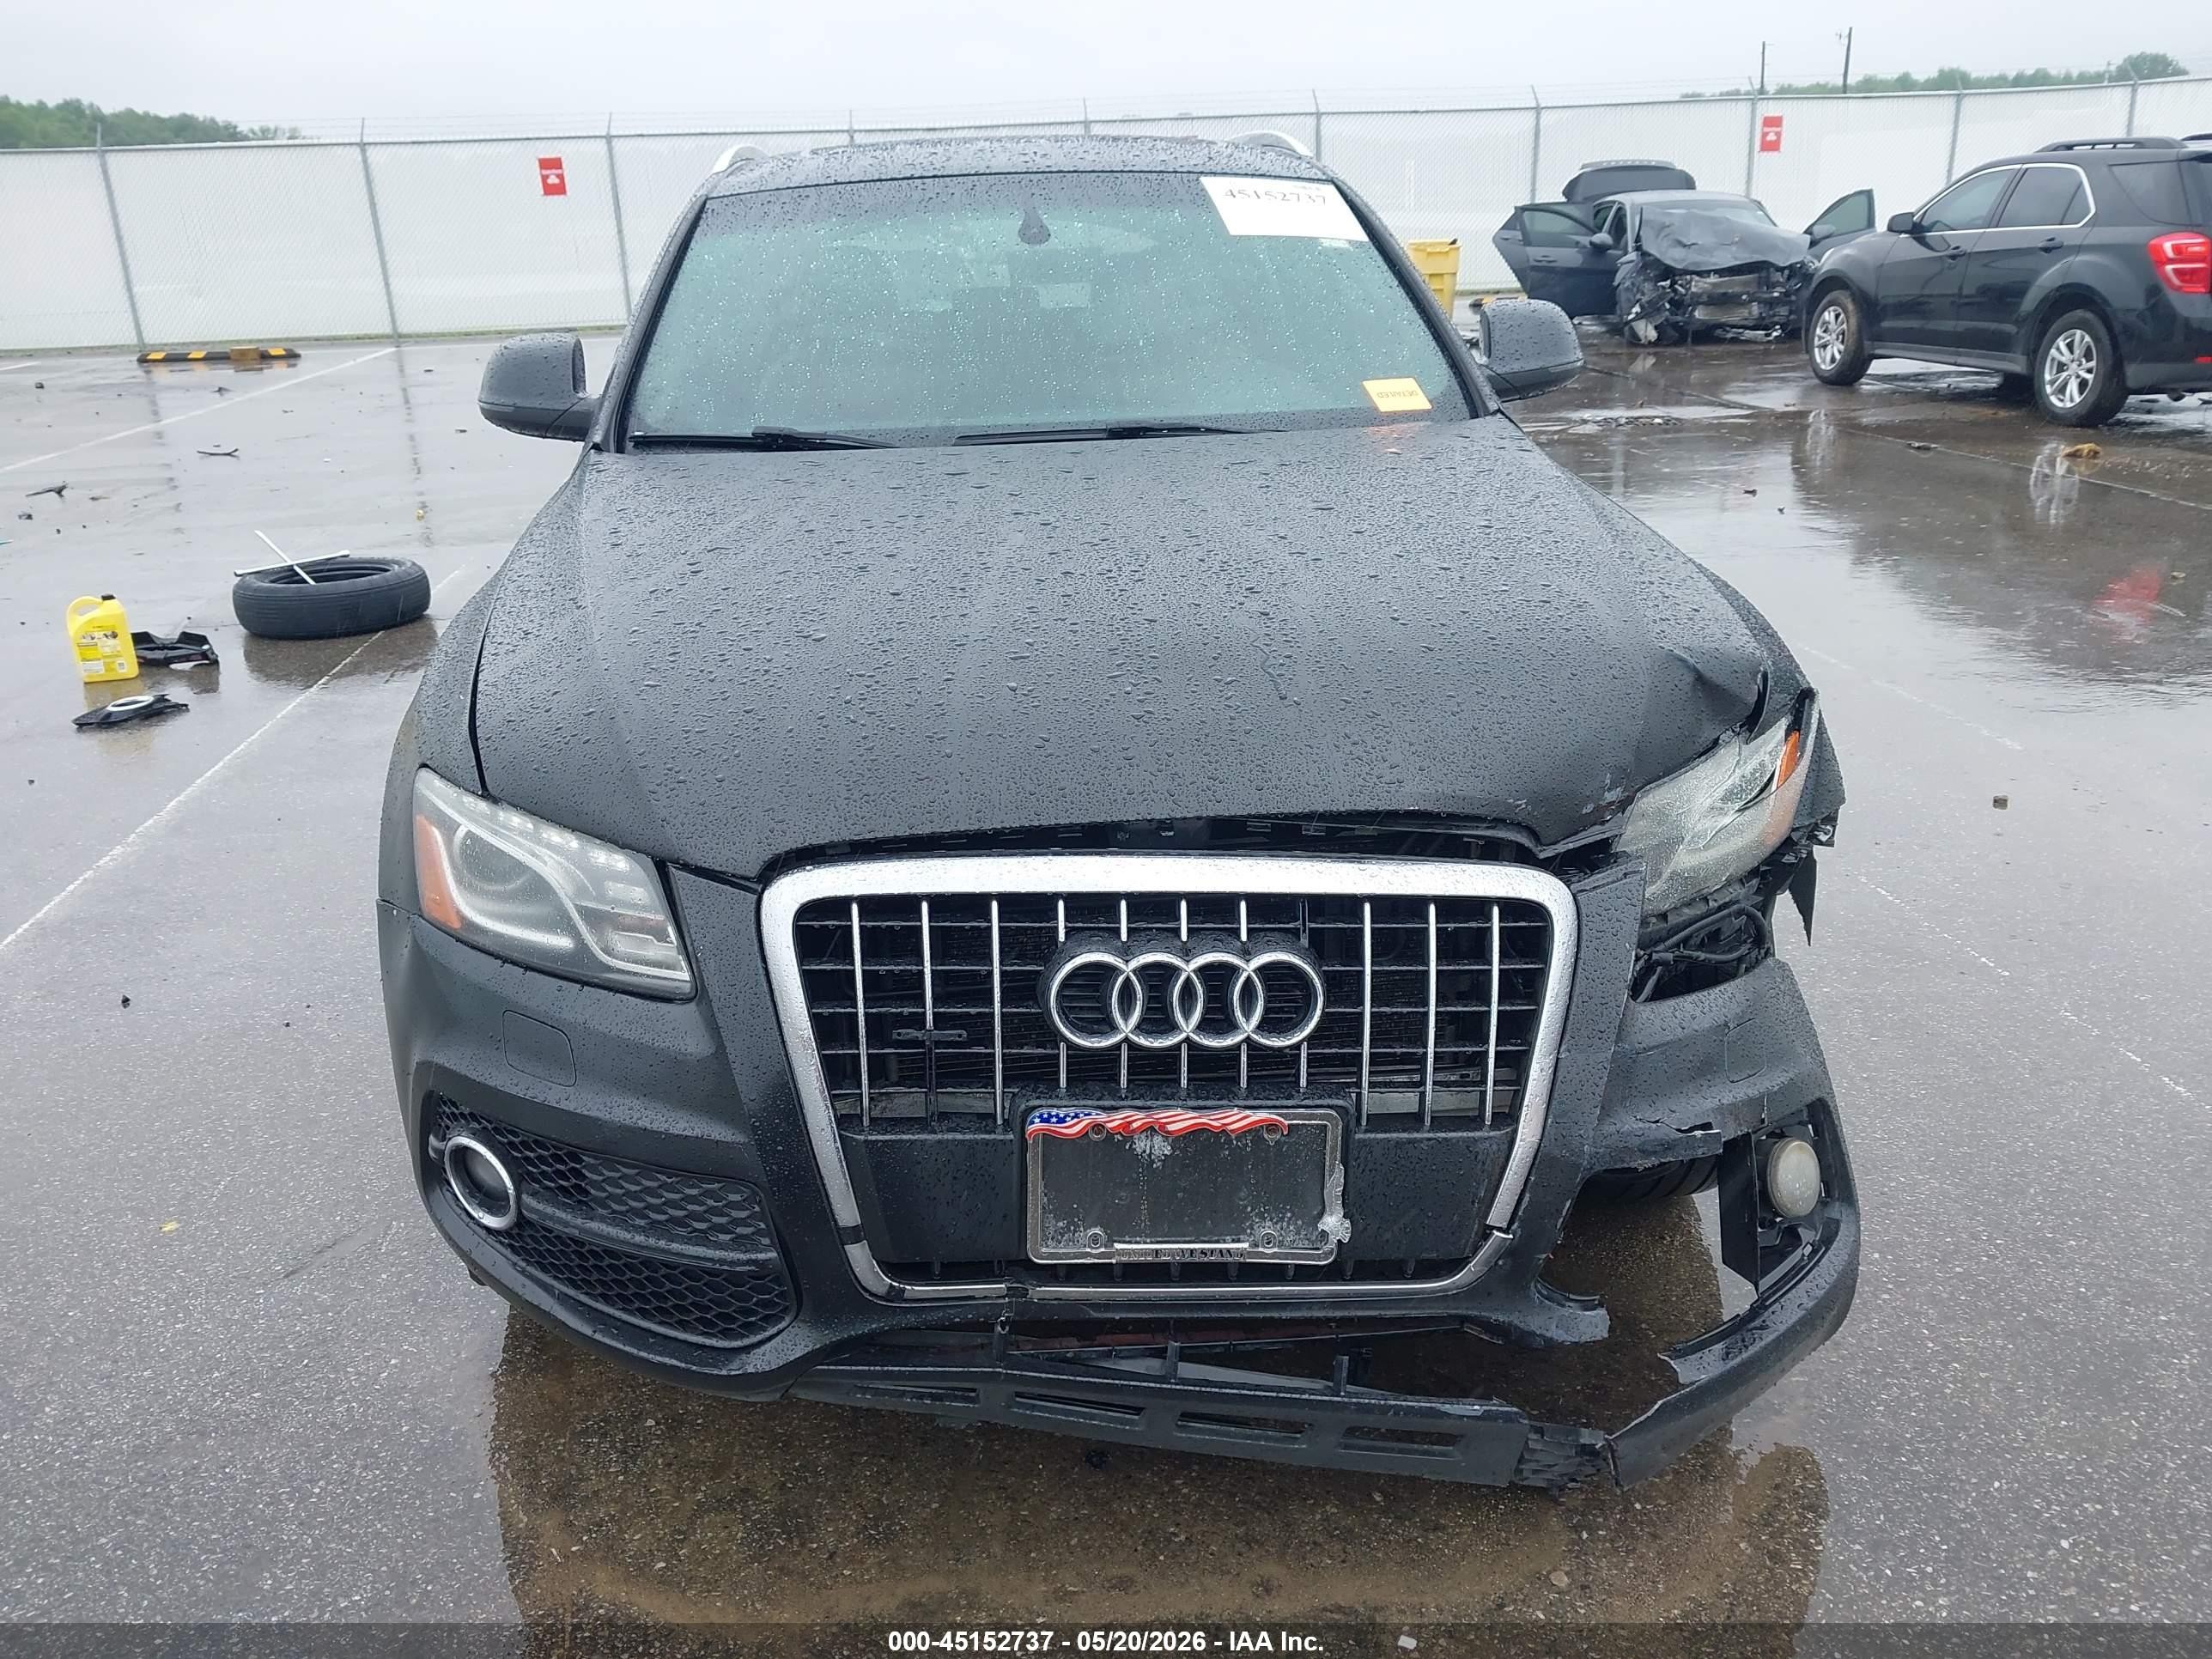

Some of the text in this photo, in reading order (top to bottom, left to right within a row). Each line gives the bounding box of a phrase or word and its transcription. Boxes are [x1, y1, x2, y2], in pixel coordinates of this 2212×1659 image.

[1224, 188, 1326, 206] 45152737
[1172, 1249, 1197, 1260] WE
[1199, 1249, 1244, 1260] STAND
